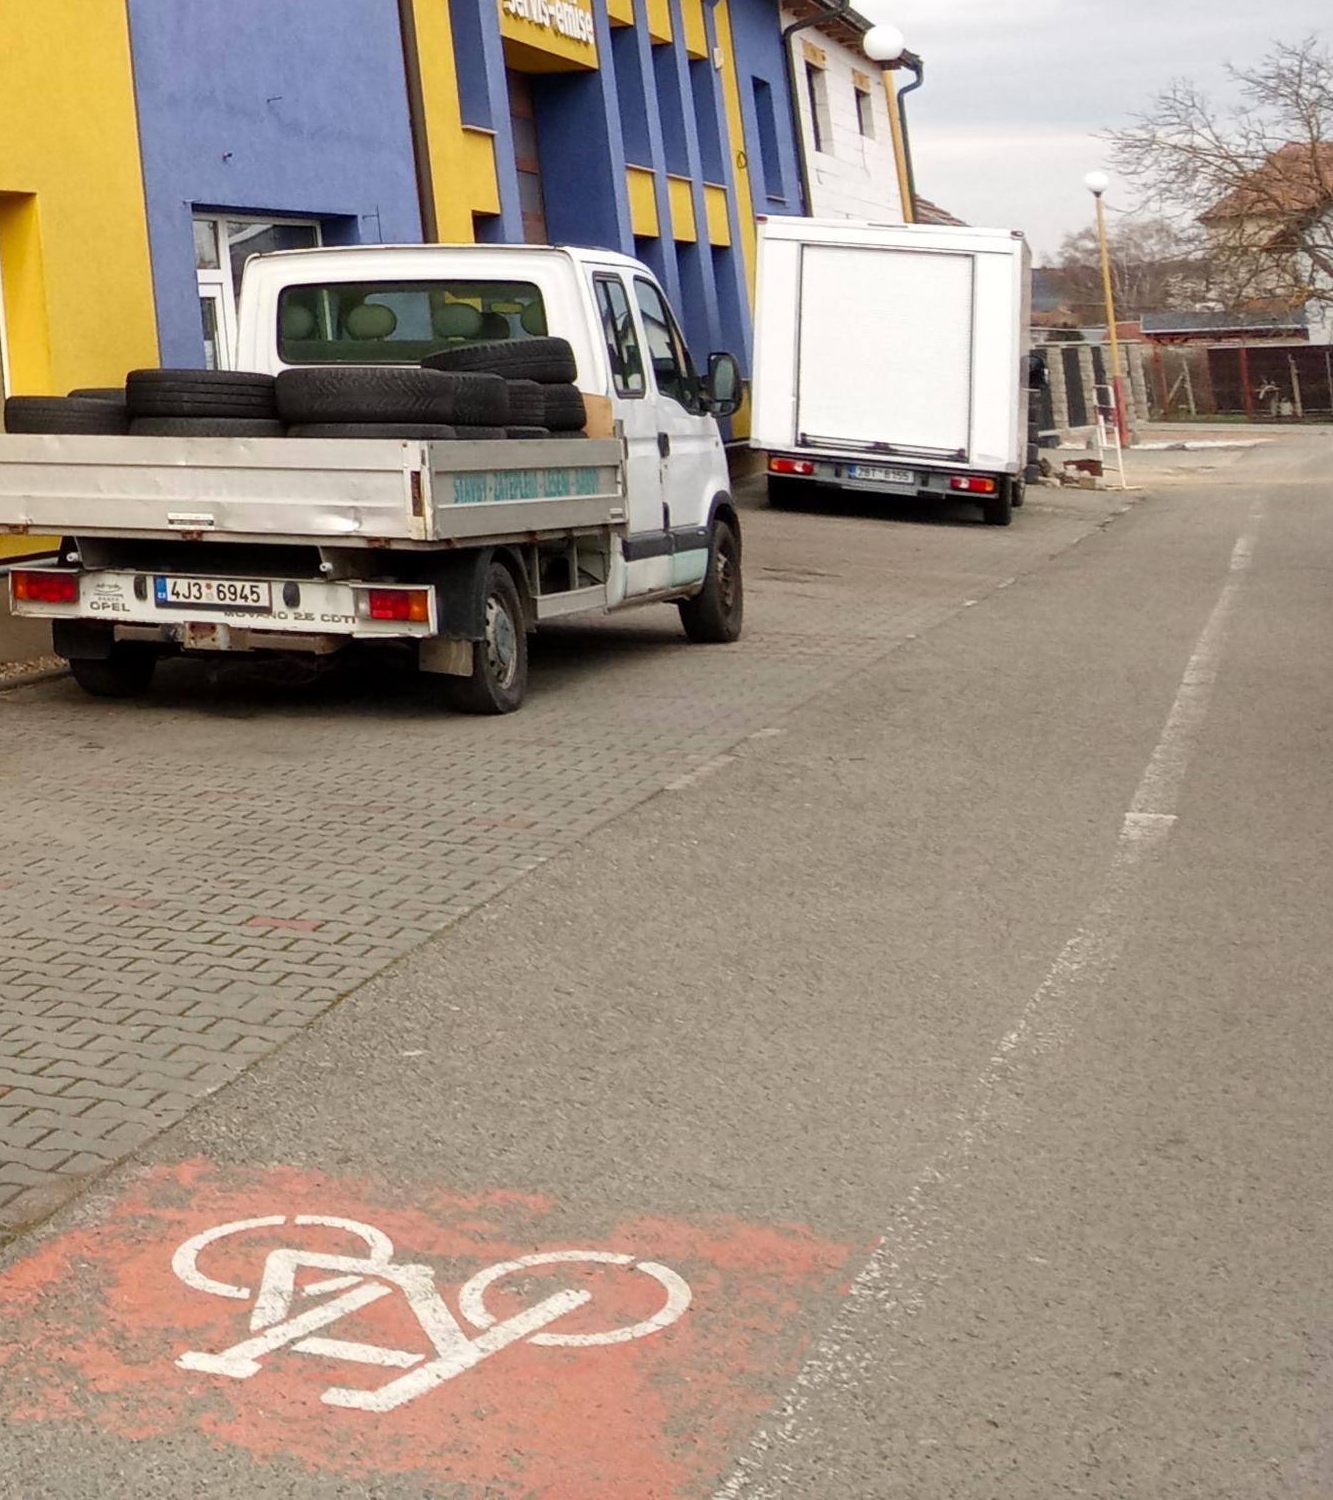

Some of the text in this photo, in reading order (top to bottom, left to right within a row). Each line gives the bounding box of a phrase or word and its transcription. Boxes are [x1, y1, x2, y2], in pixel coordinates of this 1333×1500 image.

[171, 580, 203, 601] 4J3
[216, 583, 261, 604] 6945
[89, 600, 131, 613] OPEL
